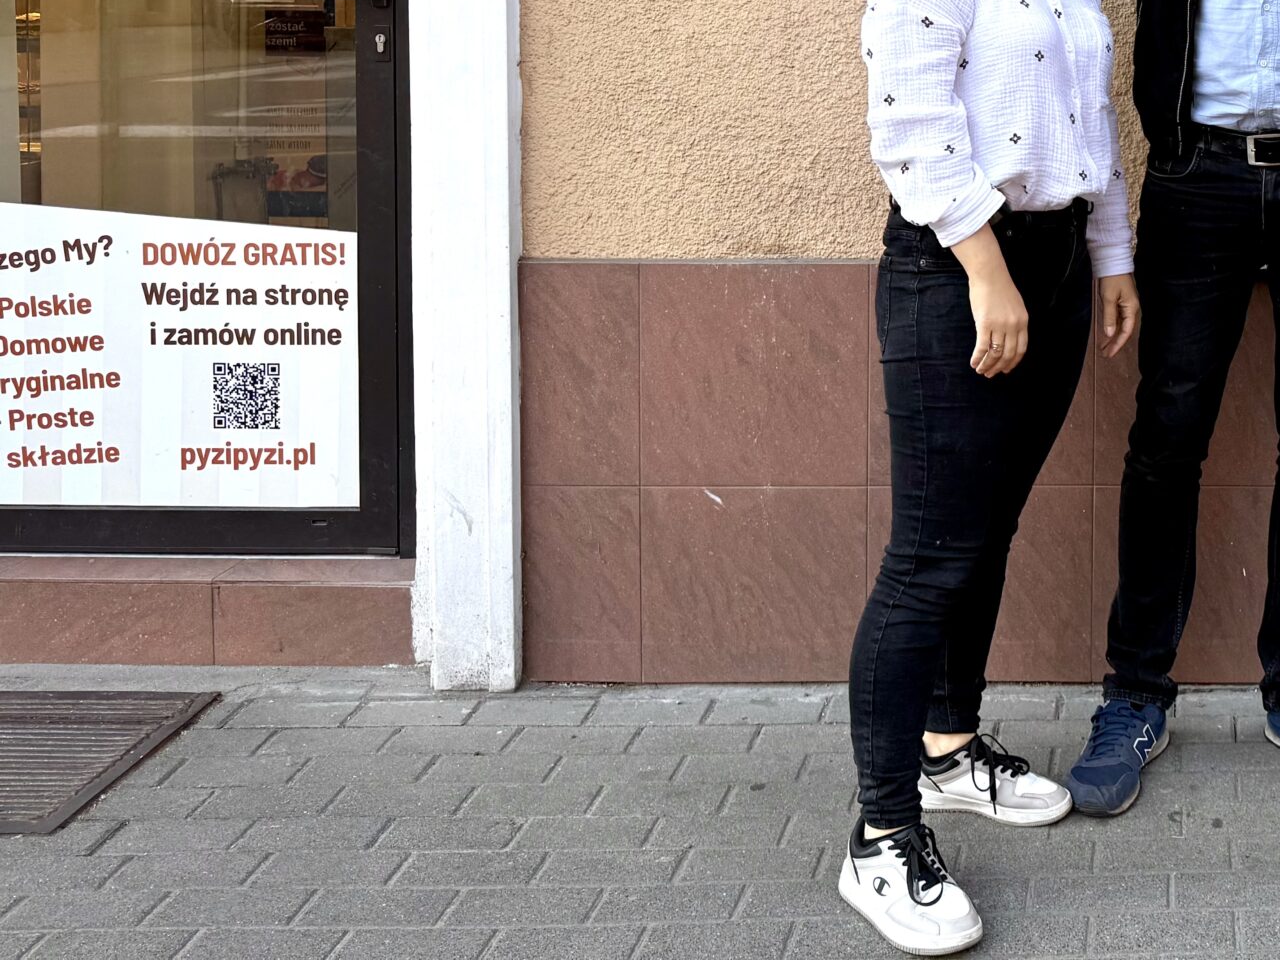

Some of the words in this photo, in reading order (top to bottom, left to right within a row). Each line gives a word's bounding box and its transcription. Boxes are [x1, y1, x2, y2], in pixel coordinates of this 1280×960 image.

[142, 237, 236, 266] DOWÓZ
[243, 243, 346, 266] GRATIS!
[0, 292, 92, 319] Polskie
[141, 282, 220, 311] Wejdź
[226, 289, 258, 305] na
[264, 284, 349, 311] stronę
[163, 323, 257, 345] zamów
[263, 321, 343, 346] online
[8, 407, 95, 431] Proste
[7, 441, 121, 469] składzie
[180, 441, 316, 470] pyzipyzi.pl
